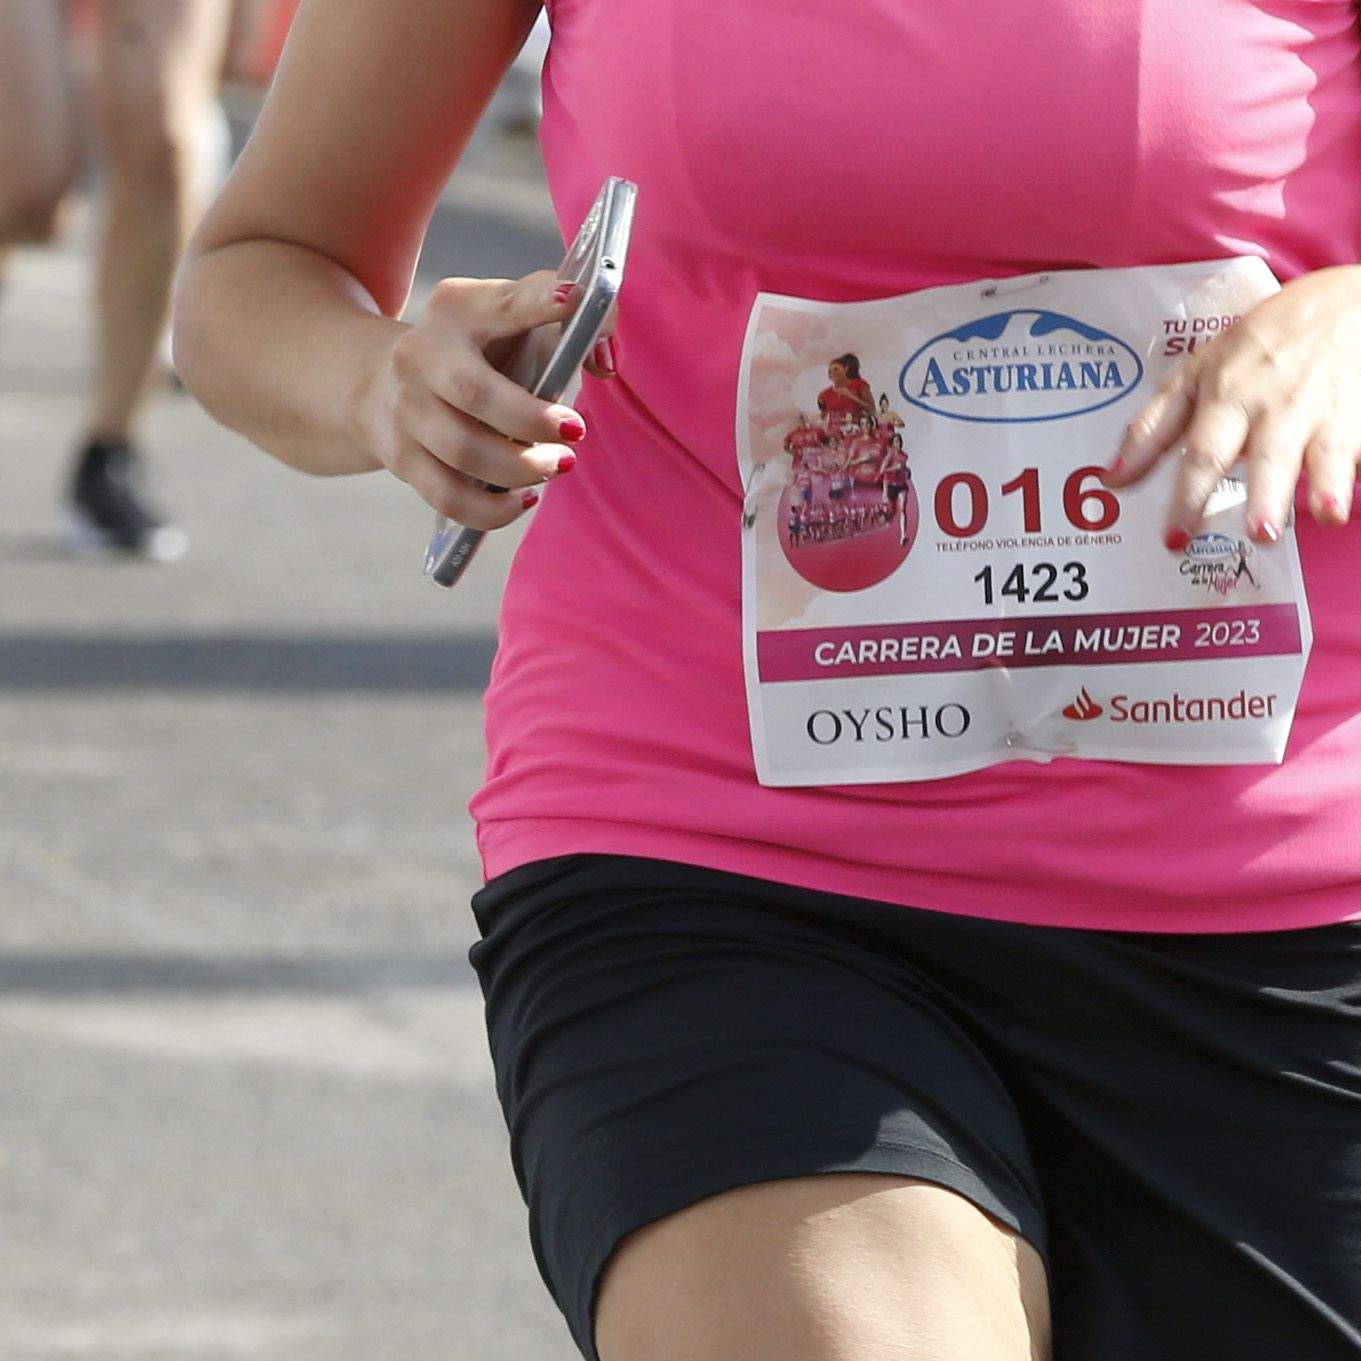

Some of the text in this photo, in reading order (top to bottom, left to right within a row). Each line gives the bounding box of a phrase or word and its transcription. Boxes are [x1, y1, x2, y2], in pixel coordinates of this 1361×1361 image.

[1163, 319, 1187, 334] TU
[953, 342, 1116, 360] CENTRAL LECHERA
[918, 356, 1124, 398] ASTURIANA
[933, 465, 1121, 539] 016
[936, 534, 1122, 552] TELÉFONO VIOLENCIA DE GÉNERO
[974, 561, 1090, 605] 1423
[814, 619, 1261, 667] CARRERA DE LA MUJER 2023
[806, 690, 1278, 746] OYSHO Santander
